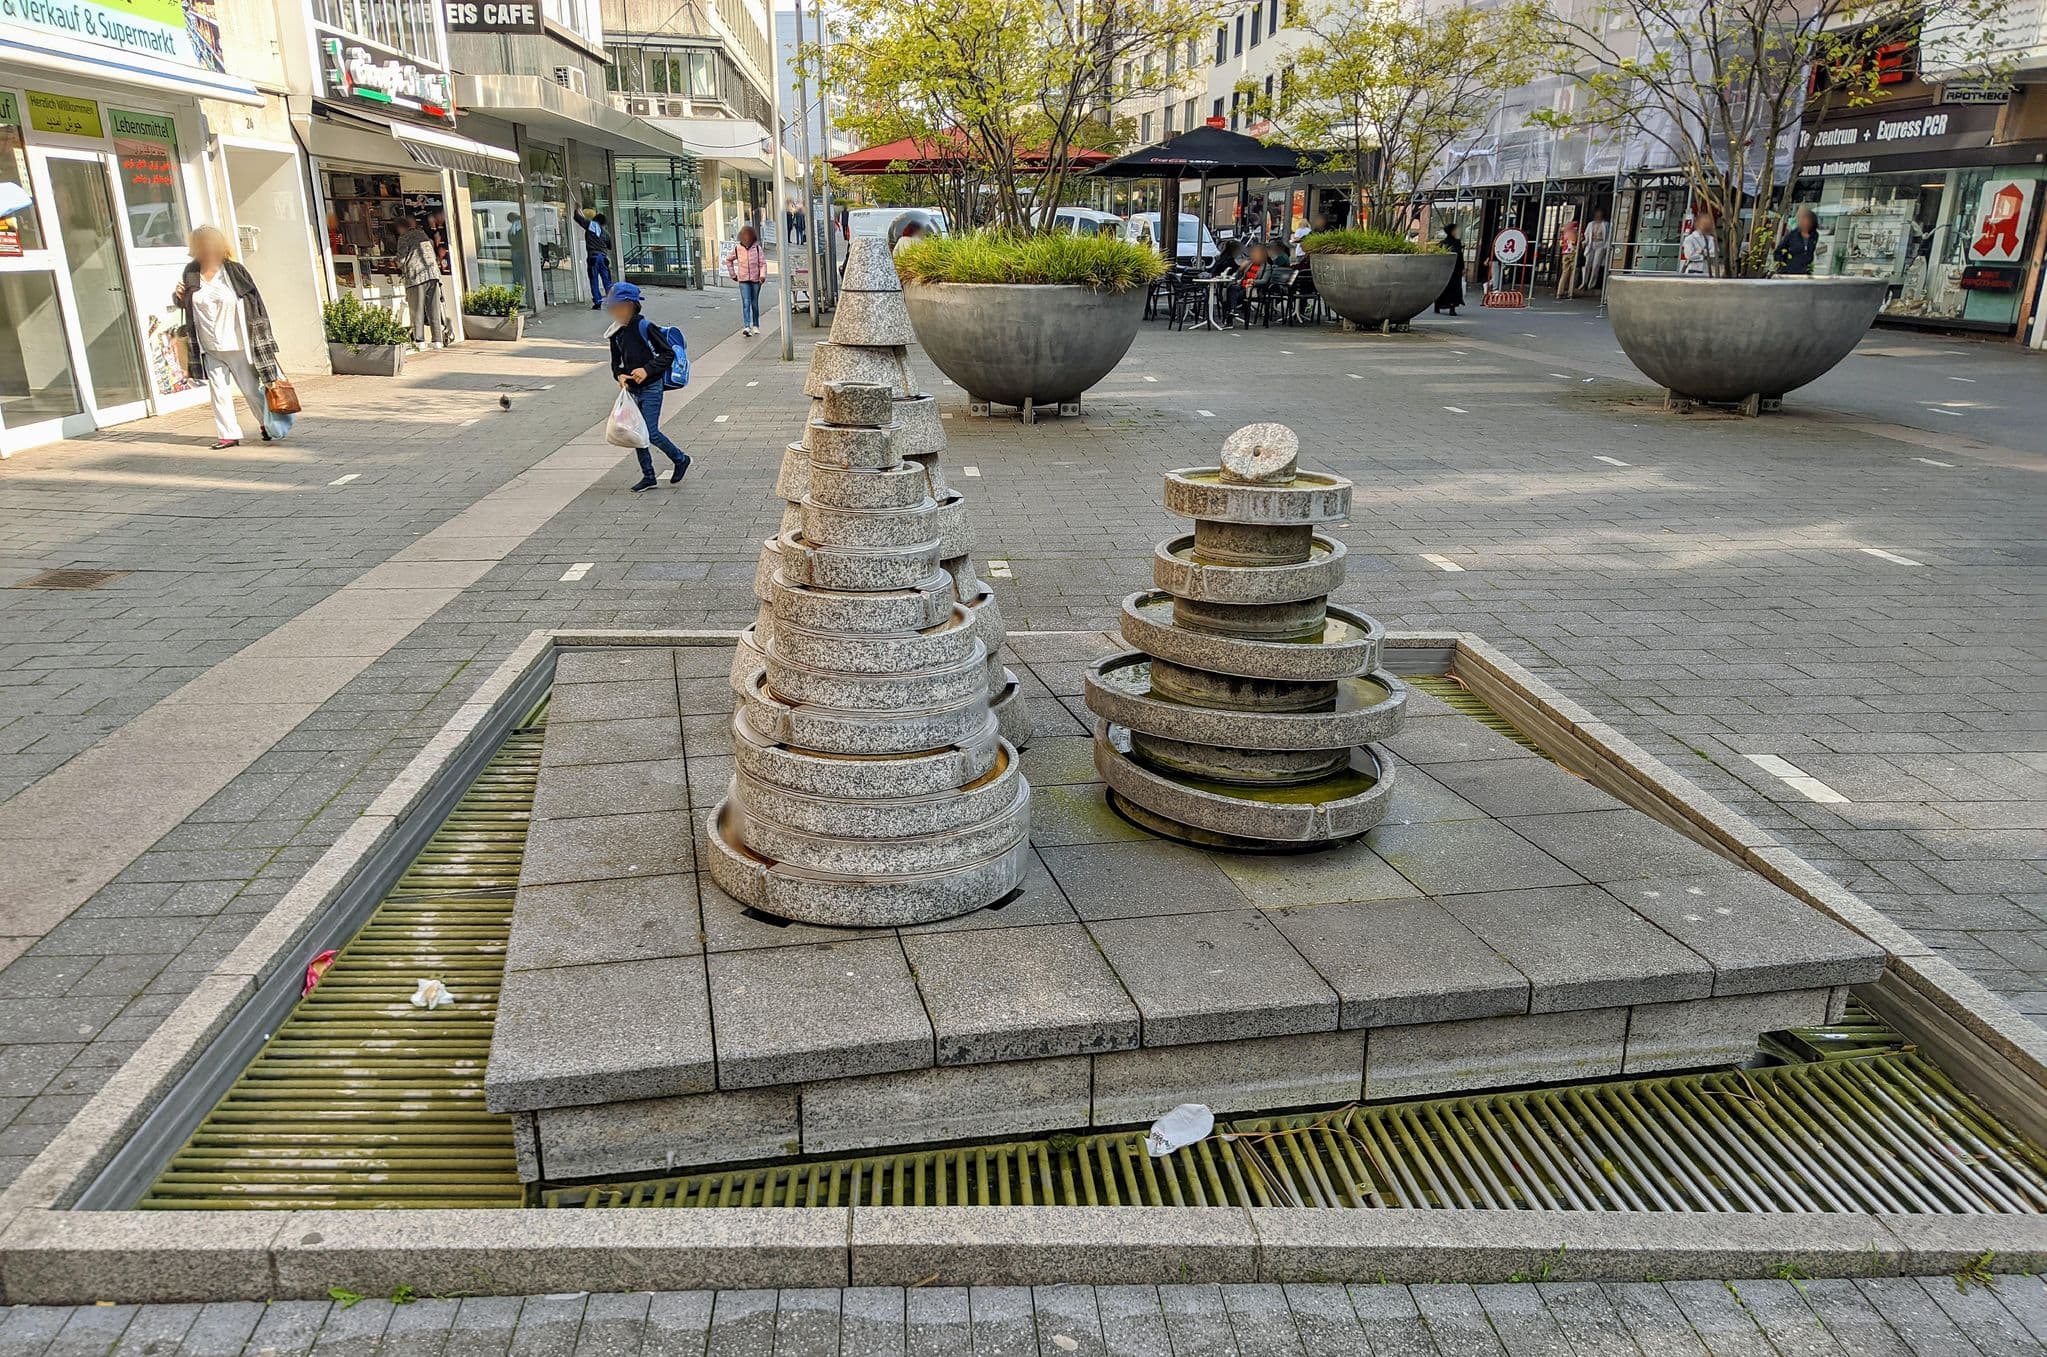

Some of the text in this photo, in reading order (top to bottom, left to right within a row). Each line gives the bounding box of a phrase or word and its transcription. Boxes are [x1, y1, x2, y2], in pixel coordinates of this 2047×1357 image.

[445, 3, 535, 25] EIS CAFE
[19, 0, 82, 33] Verkauf
[85, 8, 97, 36] &
[99, 12, 177, 56] Supermarkt
[30, 95, 93, 114] Herzlich Willkommen
[1946, 91, 2009, 101] APOTHEKE
[113, 115, 170, 138] Lebensmittel
[1876, 119, 1922, 141] Express
[1921, 114, 1949, 136] PCR
[1821, 160, 1871, 175] Antikörpertest
